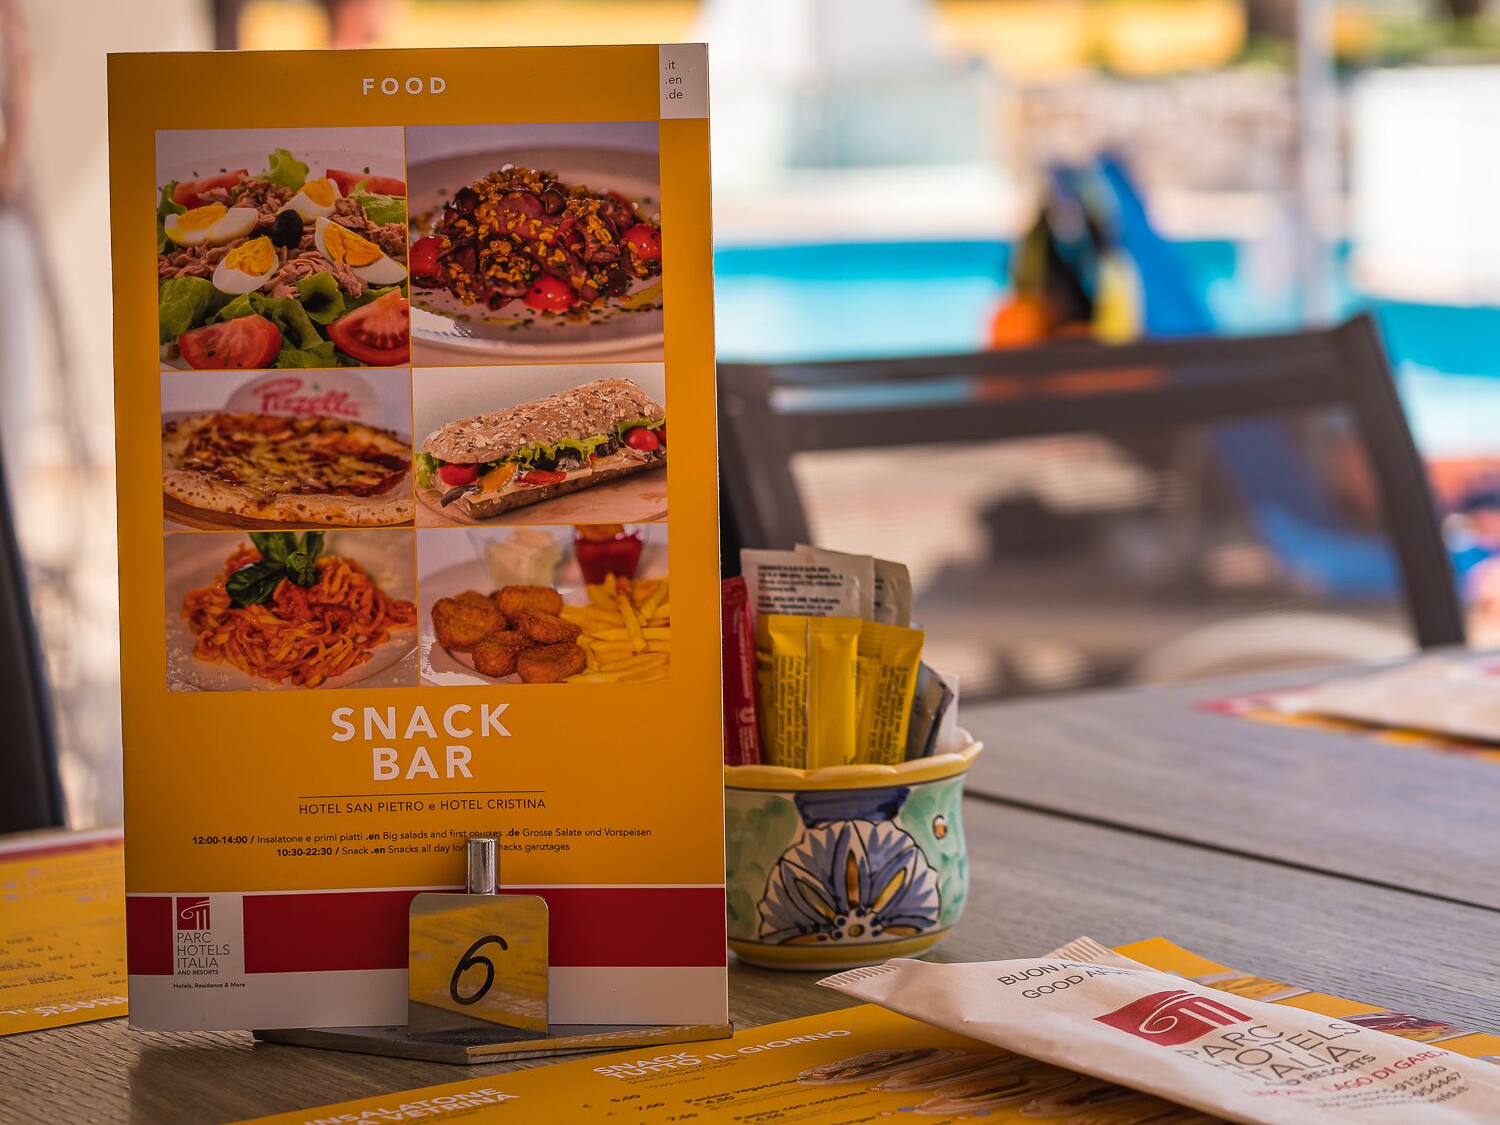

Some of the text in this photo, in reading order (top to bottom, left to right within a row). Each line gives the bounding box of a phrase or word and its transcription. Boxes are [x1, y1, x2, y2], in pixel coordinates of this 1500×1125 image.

[664, 59, 677, 70] .it
[362, 76, 446, 95] FOOD
[665, 76, 682, 85] .en
[665, 88, 684, 100] .de
[331, 703, 512, 742] SNACK
[372, 745, 474, 781] BAR
[299, 799, 546, 815] HOTEL SAN PIETRO e HOTEL CRISTINA
[192, 835, 248, 845] 12:00-14:00
[257, 834, 303, 844] Insalatone
[305, 835, 312, 843] e
[314, 833, 338, 844] primi
[339, 832, 363, 843] piatti
[365, 833, 380, 841] .en
[383, 831, 398, 842] Big
[400, 830, 428, 840] salads
[430, 829, 447, 839] and
[449, 828, 467, 838] first
[505, 828, 520, 837] .de
[522, 828, 553, 837] Grosse
[555, 827, 583, 837] Salate
[584, 828, 602, 837] und
[604, 827, 652, 838] Vorspeisen
[277, 847, 332, 857] 10:30-22:30
[342, 846, 369, 856] Snack
[371, 845, 386, 854] .en
[388, 844, 419, 854] Snacks
[421, 843, 432, 853] all
[434, 843, 450, 854] day
[452, 843, 467, 853] lon
[499, 842, 523, 853] nacks
[525, 842, 570, 854] ganztages
[176, 931, 212, 943] PARC
[177, 944, 231, 956] HOTELS
[177, 957, 219, 969] ITALIA
[450, 935, 508, 1005] 6
[997, 964, 1060, 986] BUON
[1021, 975, 1084, 999] GOOD
[1175, 1024, 1285, 1060] PARC
[1202, 1023, 1361, 1071] HOTELS
[593, 1051, 699, 1075] SNACK
[604, 1058, 702, 1080] TUTTO
[706, 1053, 737, 1063] IL
[737, 1029, 852, 1055] GIORNO
[1231, 1041, 1362, 1081] ITALIA
[1301, 1054, 1377, 1081] RESORTS
[1371, 1066, 1396, 1080] DI
[303, 1088, 499, 1125] INSALATONE
[381, 1092, 521, 1121] VETRINA
